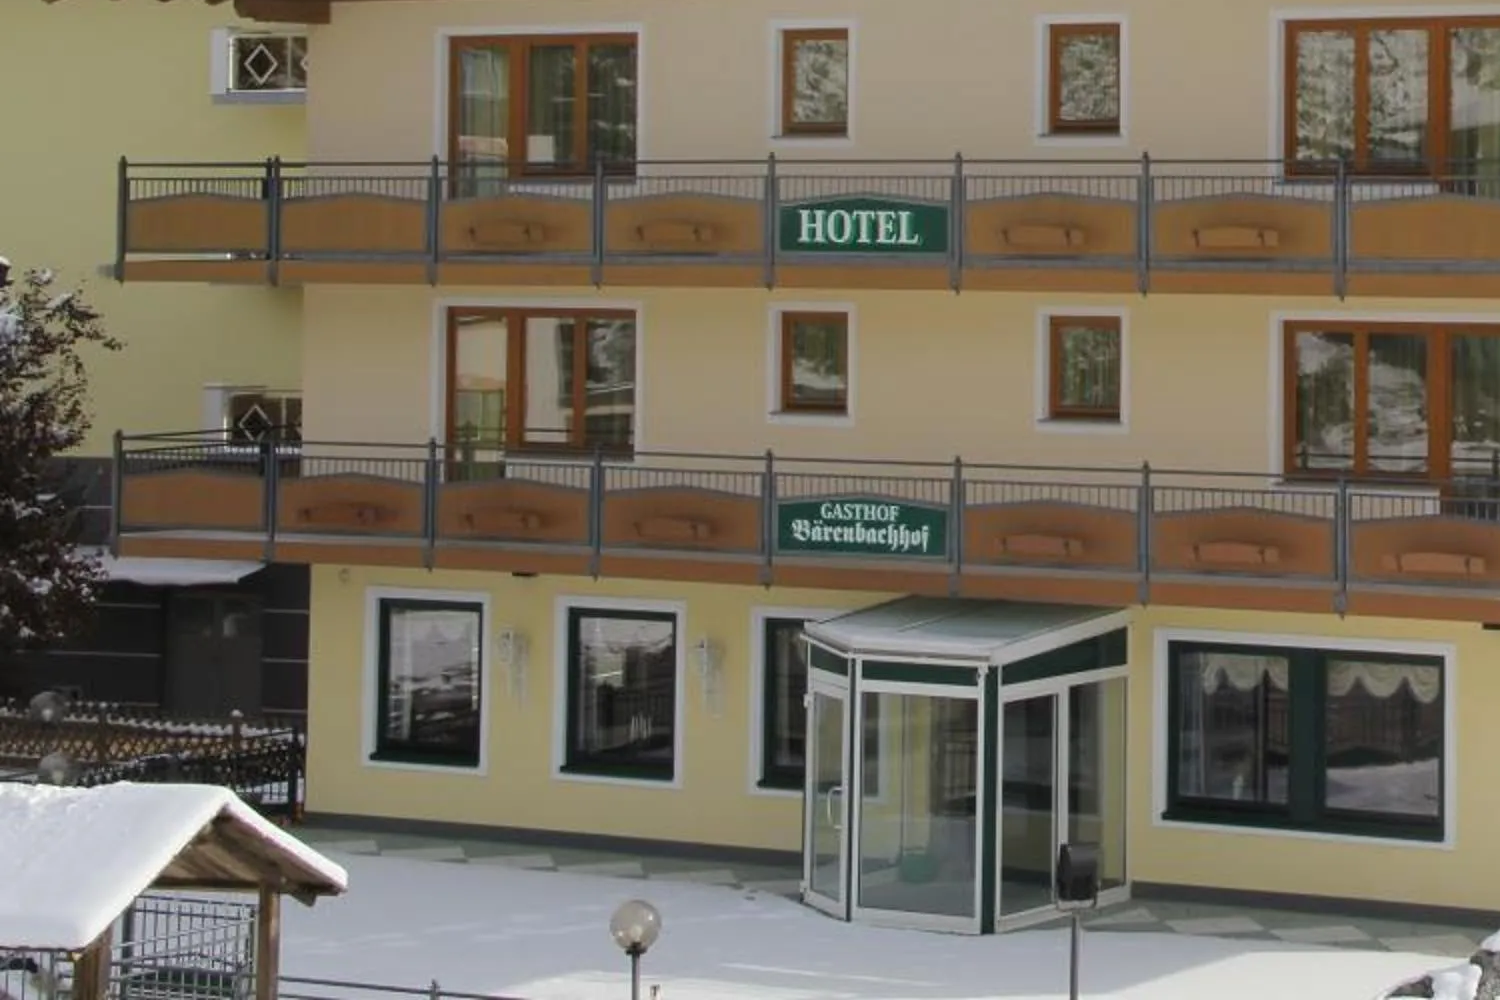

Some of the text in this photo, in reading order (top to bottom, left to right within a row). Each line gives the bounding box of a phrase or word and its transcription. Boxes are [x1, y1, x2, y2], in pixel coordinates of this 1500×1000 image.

[797, 209, 919, 245] HOTEL
[820, 502, 900, 522] GASTHOF
[791, 518, 930, 552] Bärenbachhof
